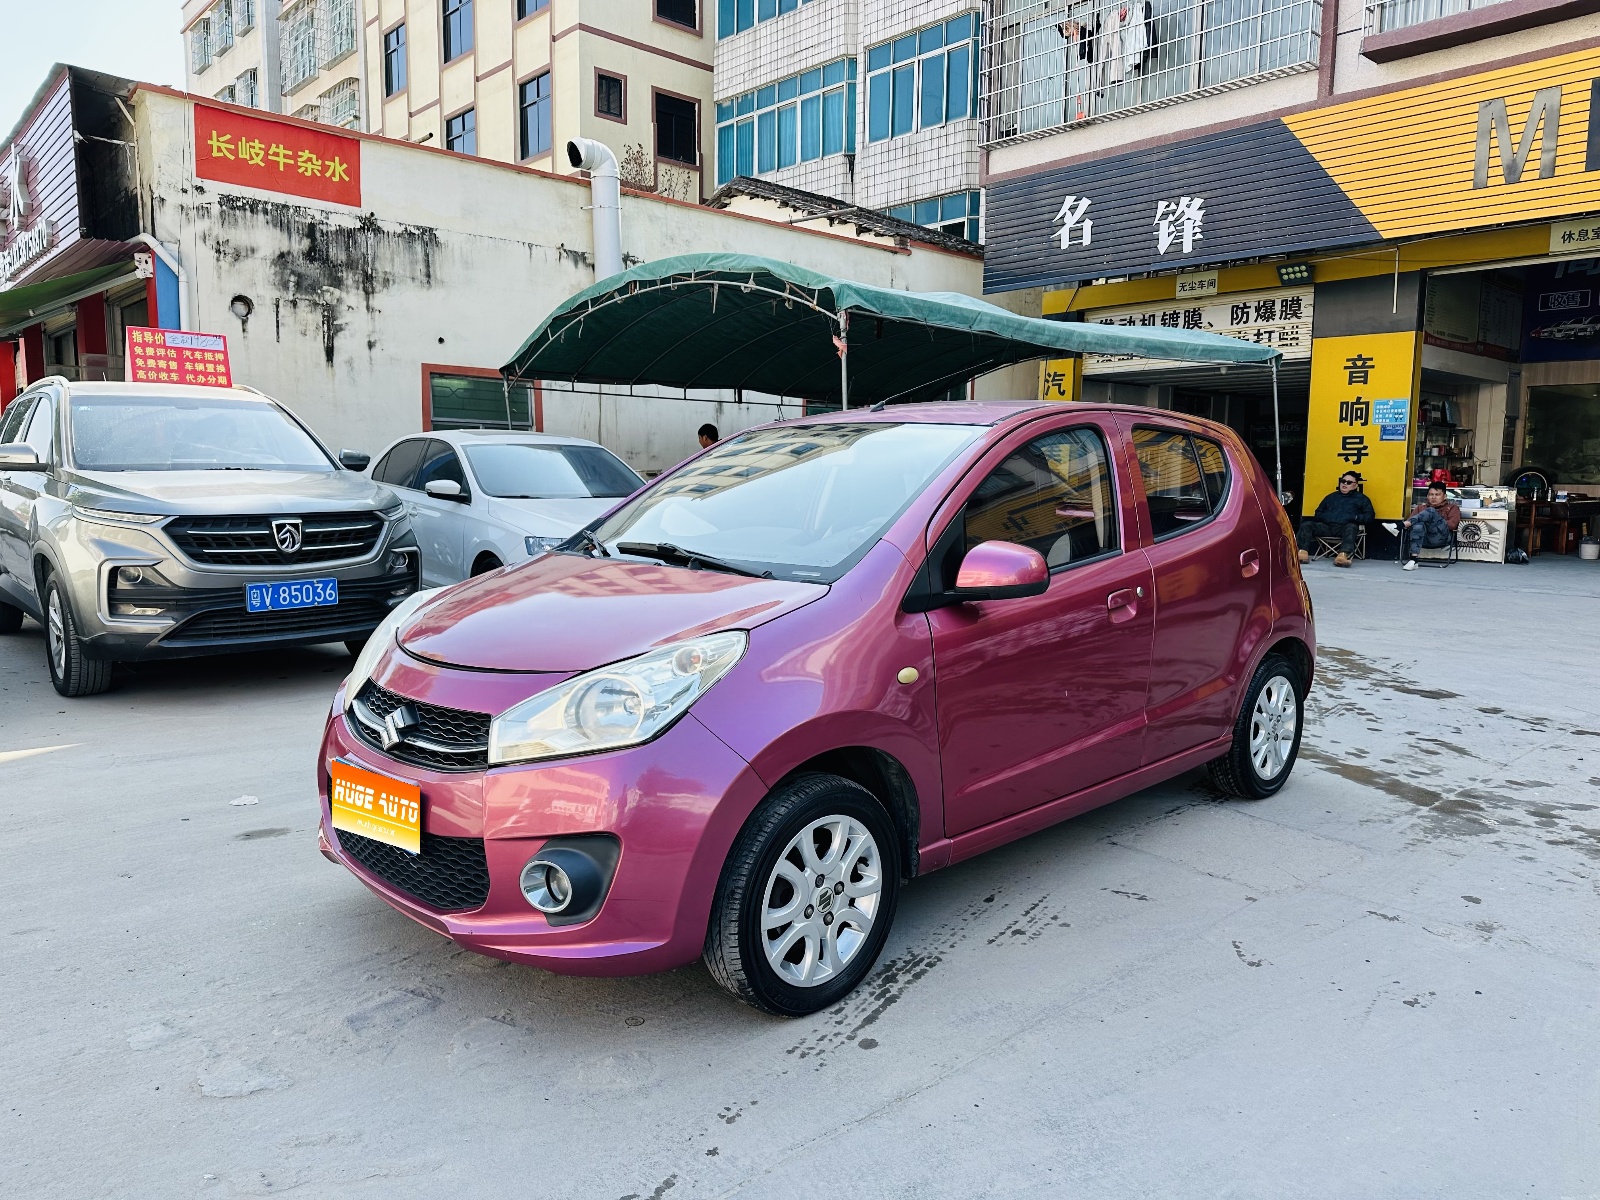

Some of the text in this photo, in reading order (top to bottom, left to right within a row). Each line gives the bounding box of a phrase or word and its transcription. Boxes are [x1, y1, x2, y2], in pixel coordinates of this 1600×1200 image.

[1473, 77, 1600, 189] M
[207, 130, 350, 182] 长岐牛杂水
[1561, 227, 1600, 244] 休息室
[1178, 278, 1217, 293] 无尘车间
[132, 329, 165, 345] 指导价
[134, 346, 225, 362] 免费评估 汽车抵押
[135, 358, 226, 373] 免费寄售 车辆置换
[136, 370, 228, 385] 高价收车 代办分期
[250, 582, 336, 608] 粤V·85036
